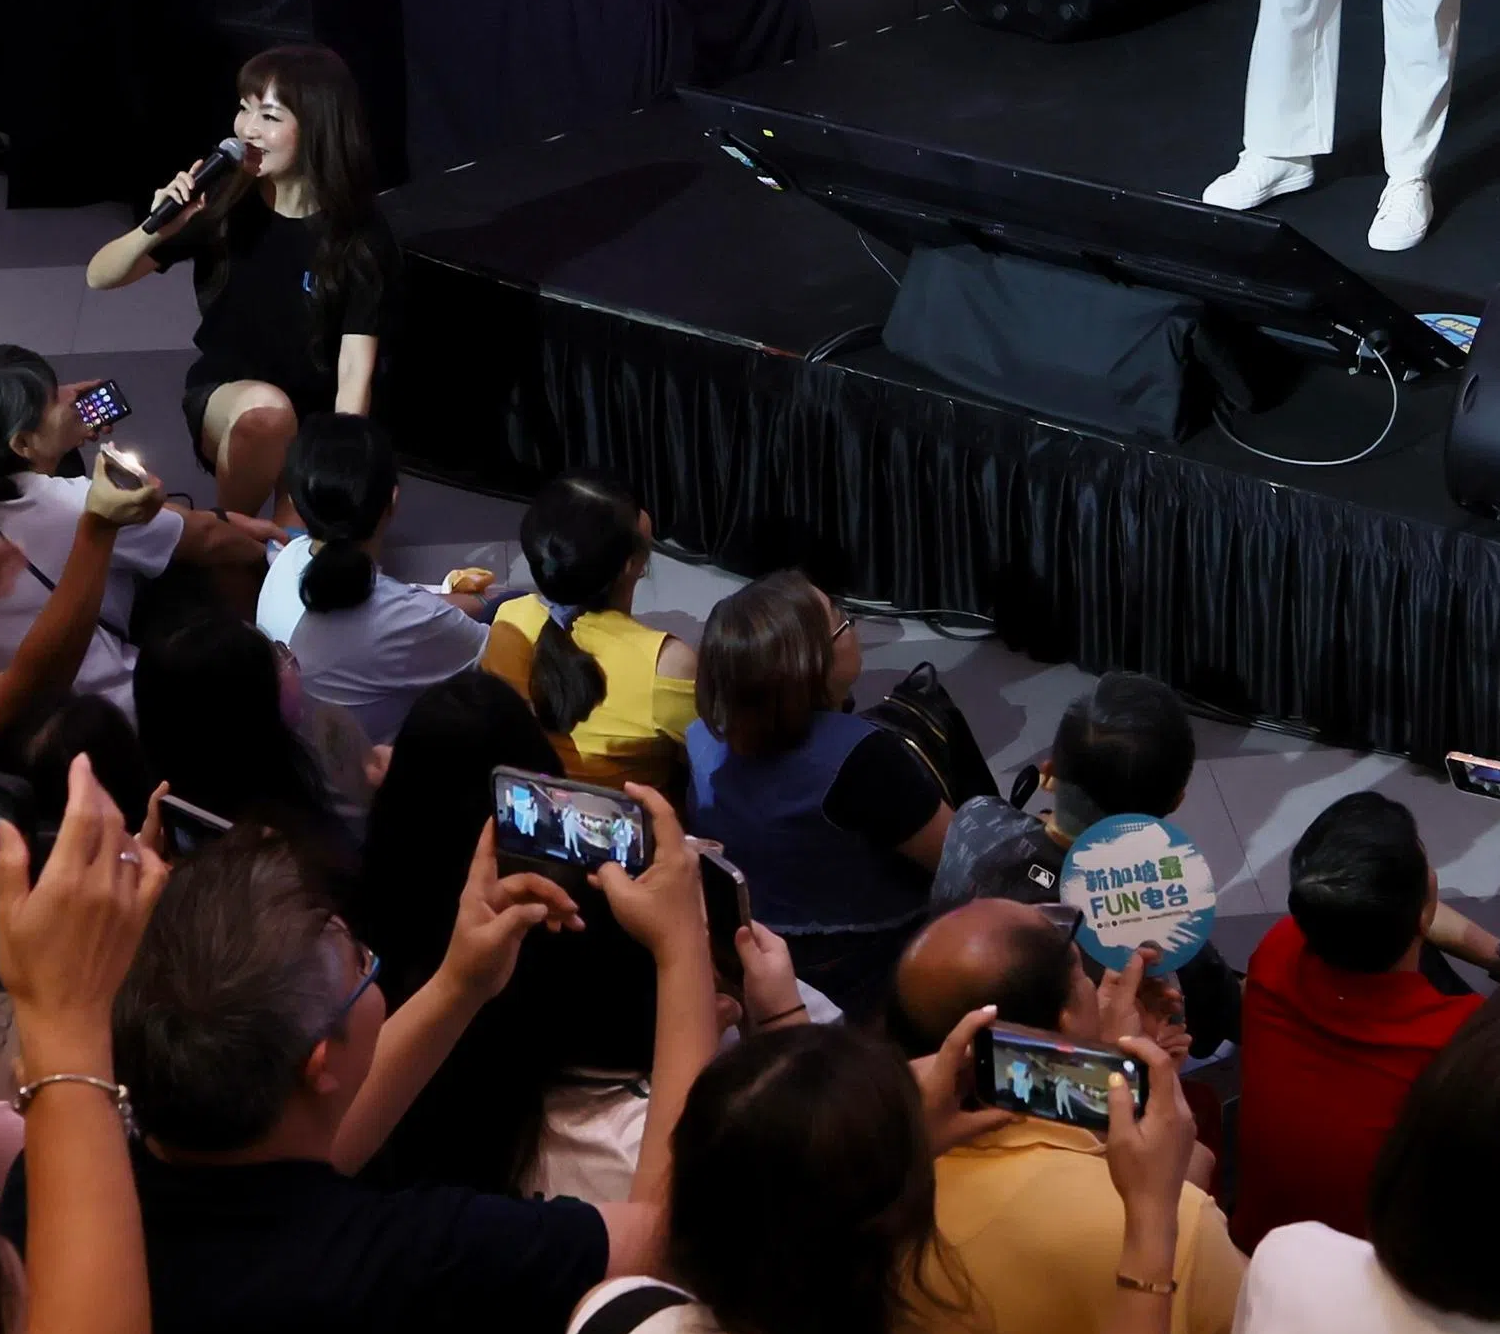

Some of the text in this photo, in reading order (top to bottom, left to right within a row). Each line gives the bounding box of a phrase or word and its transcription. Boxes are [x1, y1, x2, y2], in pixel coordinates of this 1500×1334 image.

[1085, 855, 1184, 893] 新加坡最
[1090, 883, 1190, 919] FUN电台
